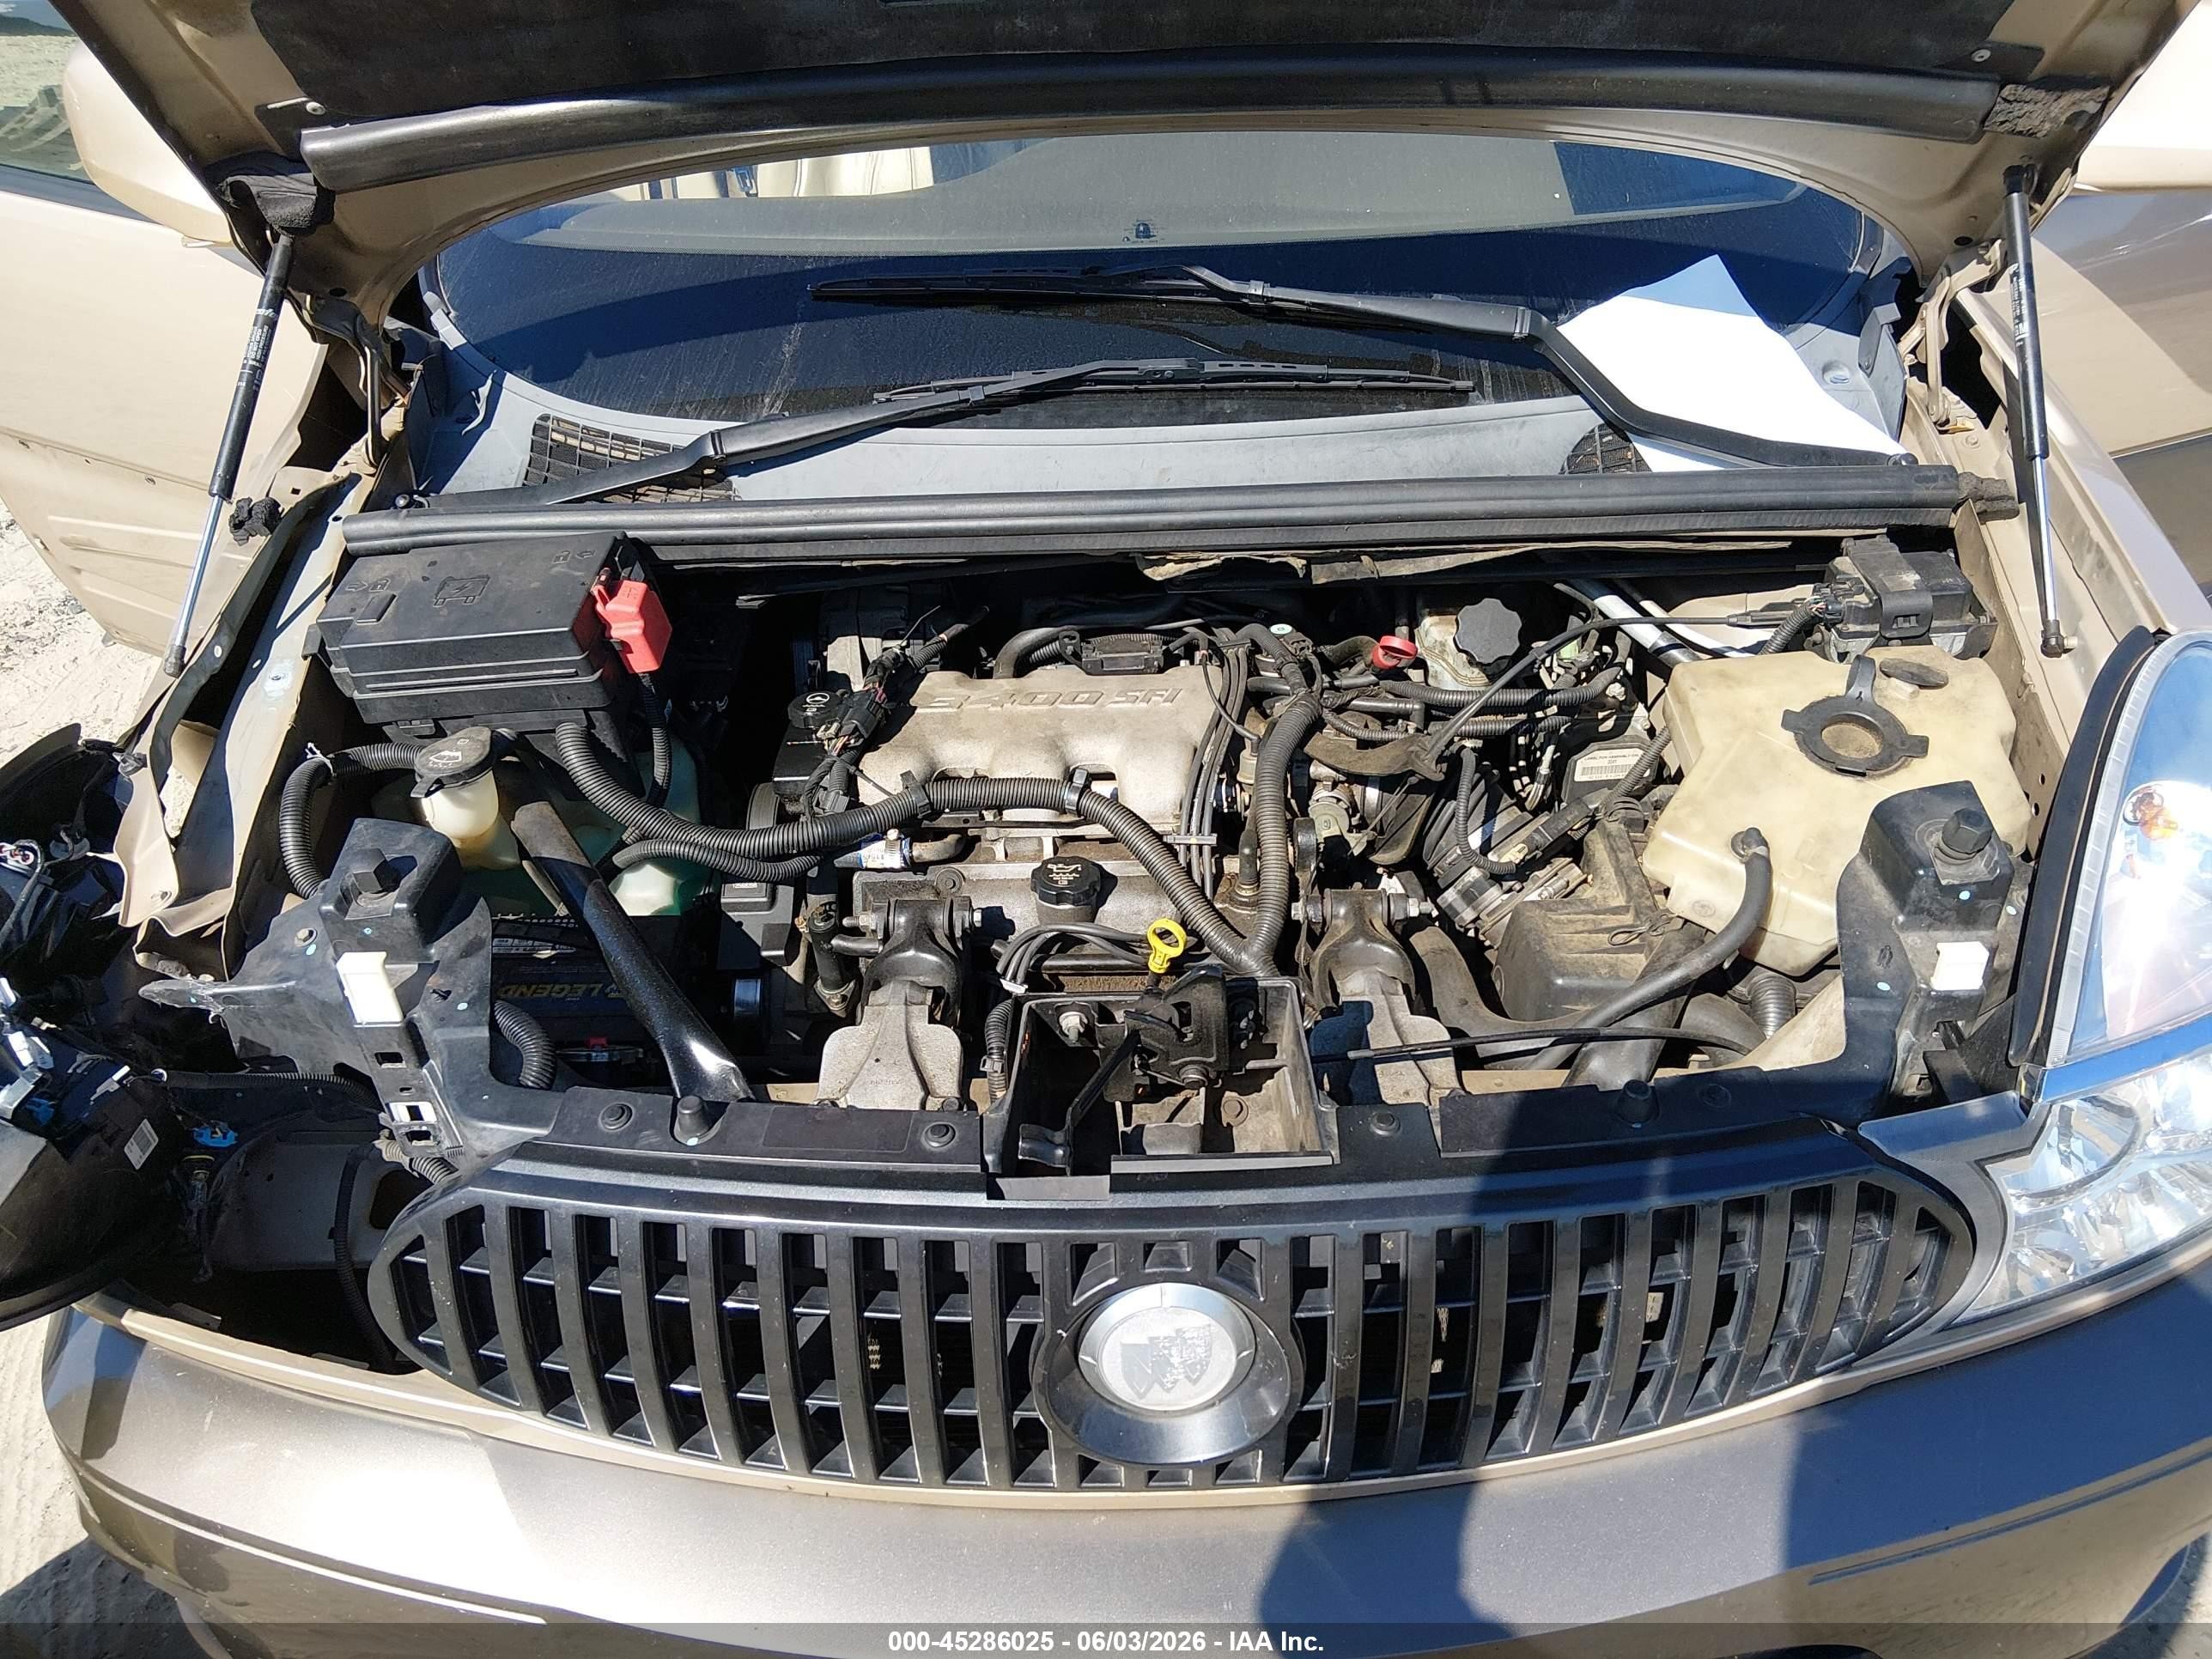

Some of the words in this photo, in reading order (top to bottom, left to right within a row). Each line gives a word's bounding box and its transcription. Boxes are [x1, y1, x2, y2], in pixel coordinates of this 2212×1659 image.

[915, 690, 1104, 712] 3400
[1106, 688, 1182, 708] SFI
[499, 983, 604, 998] LEGEND
